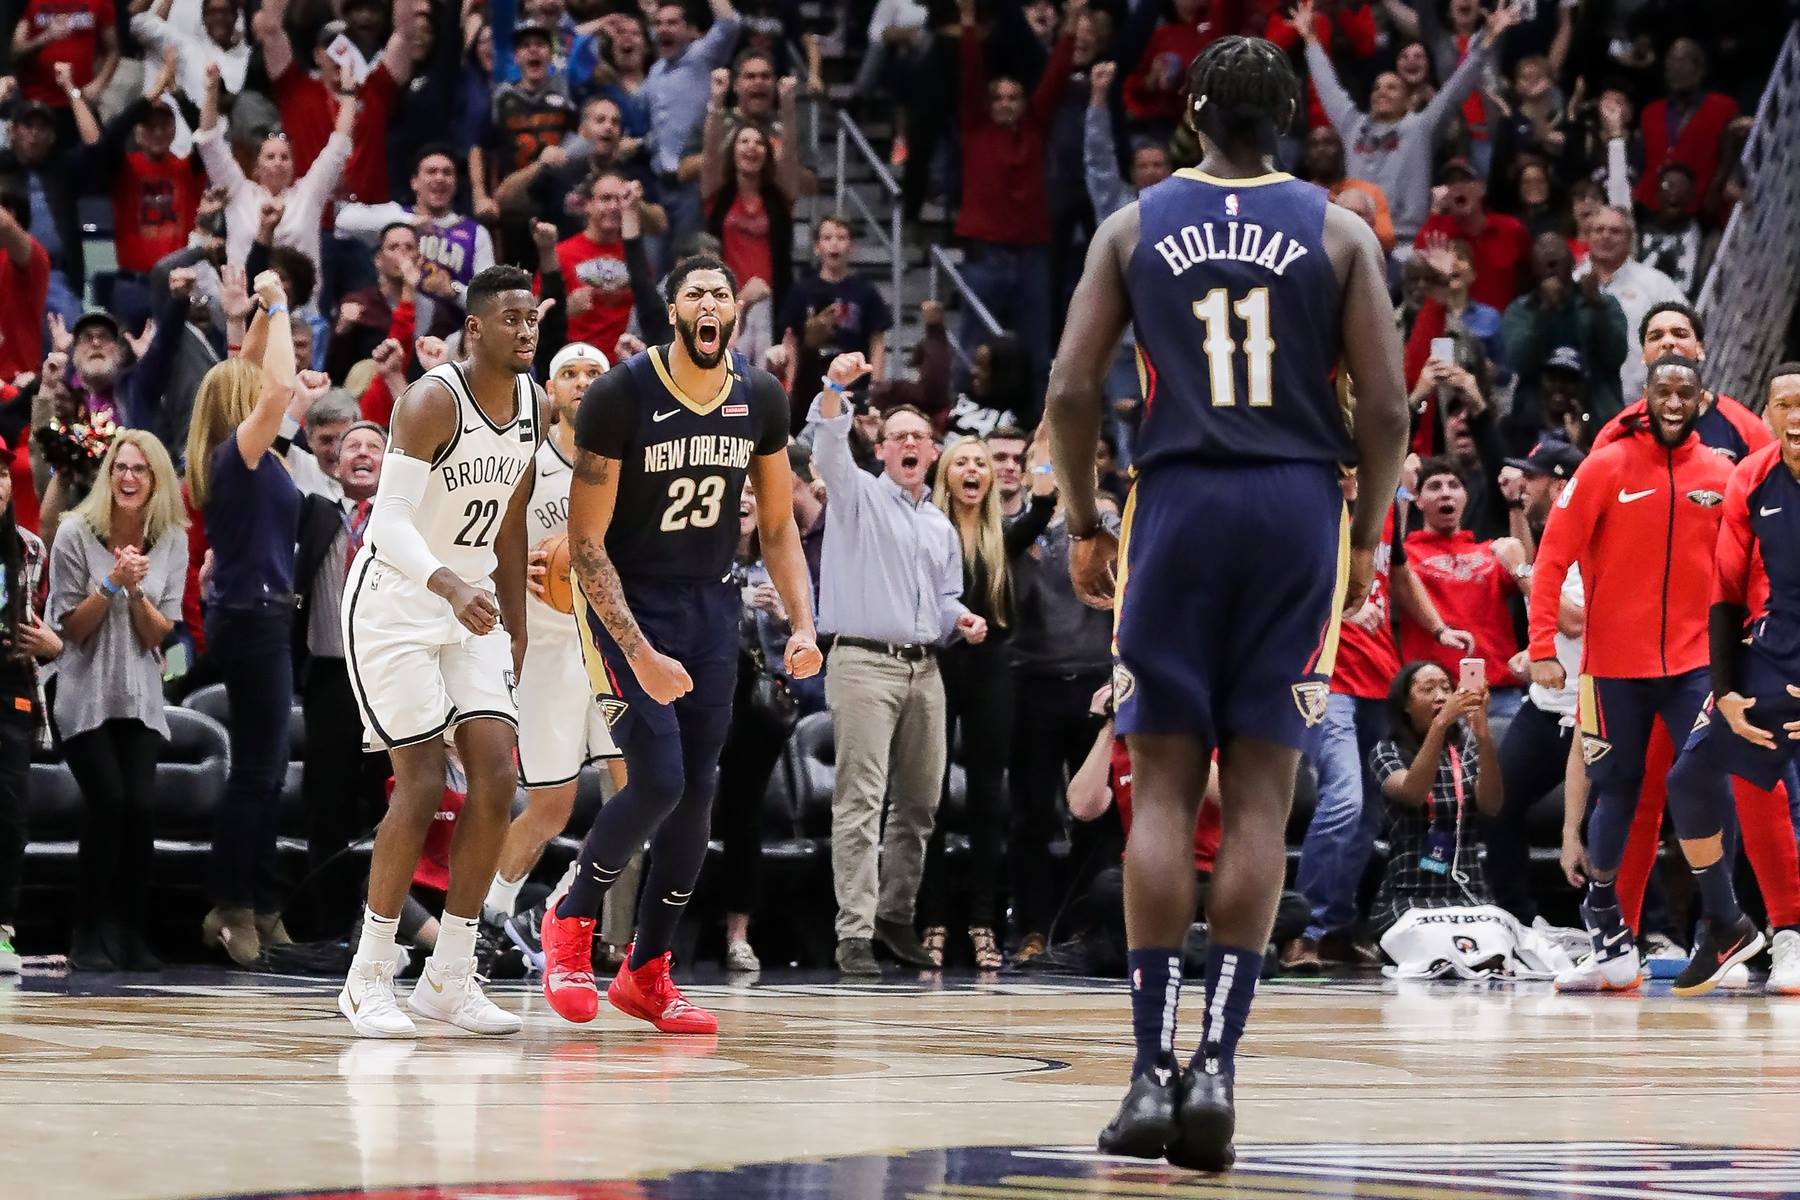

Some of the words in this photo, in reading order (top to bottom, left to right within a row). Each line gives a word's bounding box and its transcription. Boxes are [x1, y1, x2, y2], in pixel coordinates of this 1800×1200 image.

[1154, 221, 1308, 277] HOLIDAY
[1192, 287, 1276, 407] 11
[442, 455, 526, 492] BROOKLY
[644, 437, 687, 473] NEW
[689, 434, 755, 469] ORLEANS
[453, 499, 499, 547] 22
[660, 475, 726, 532] 23
